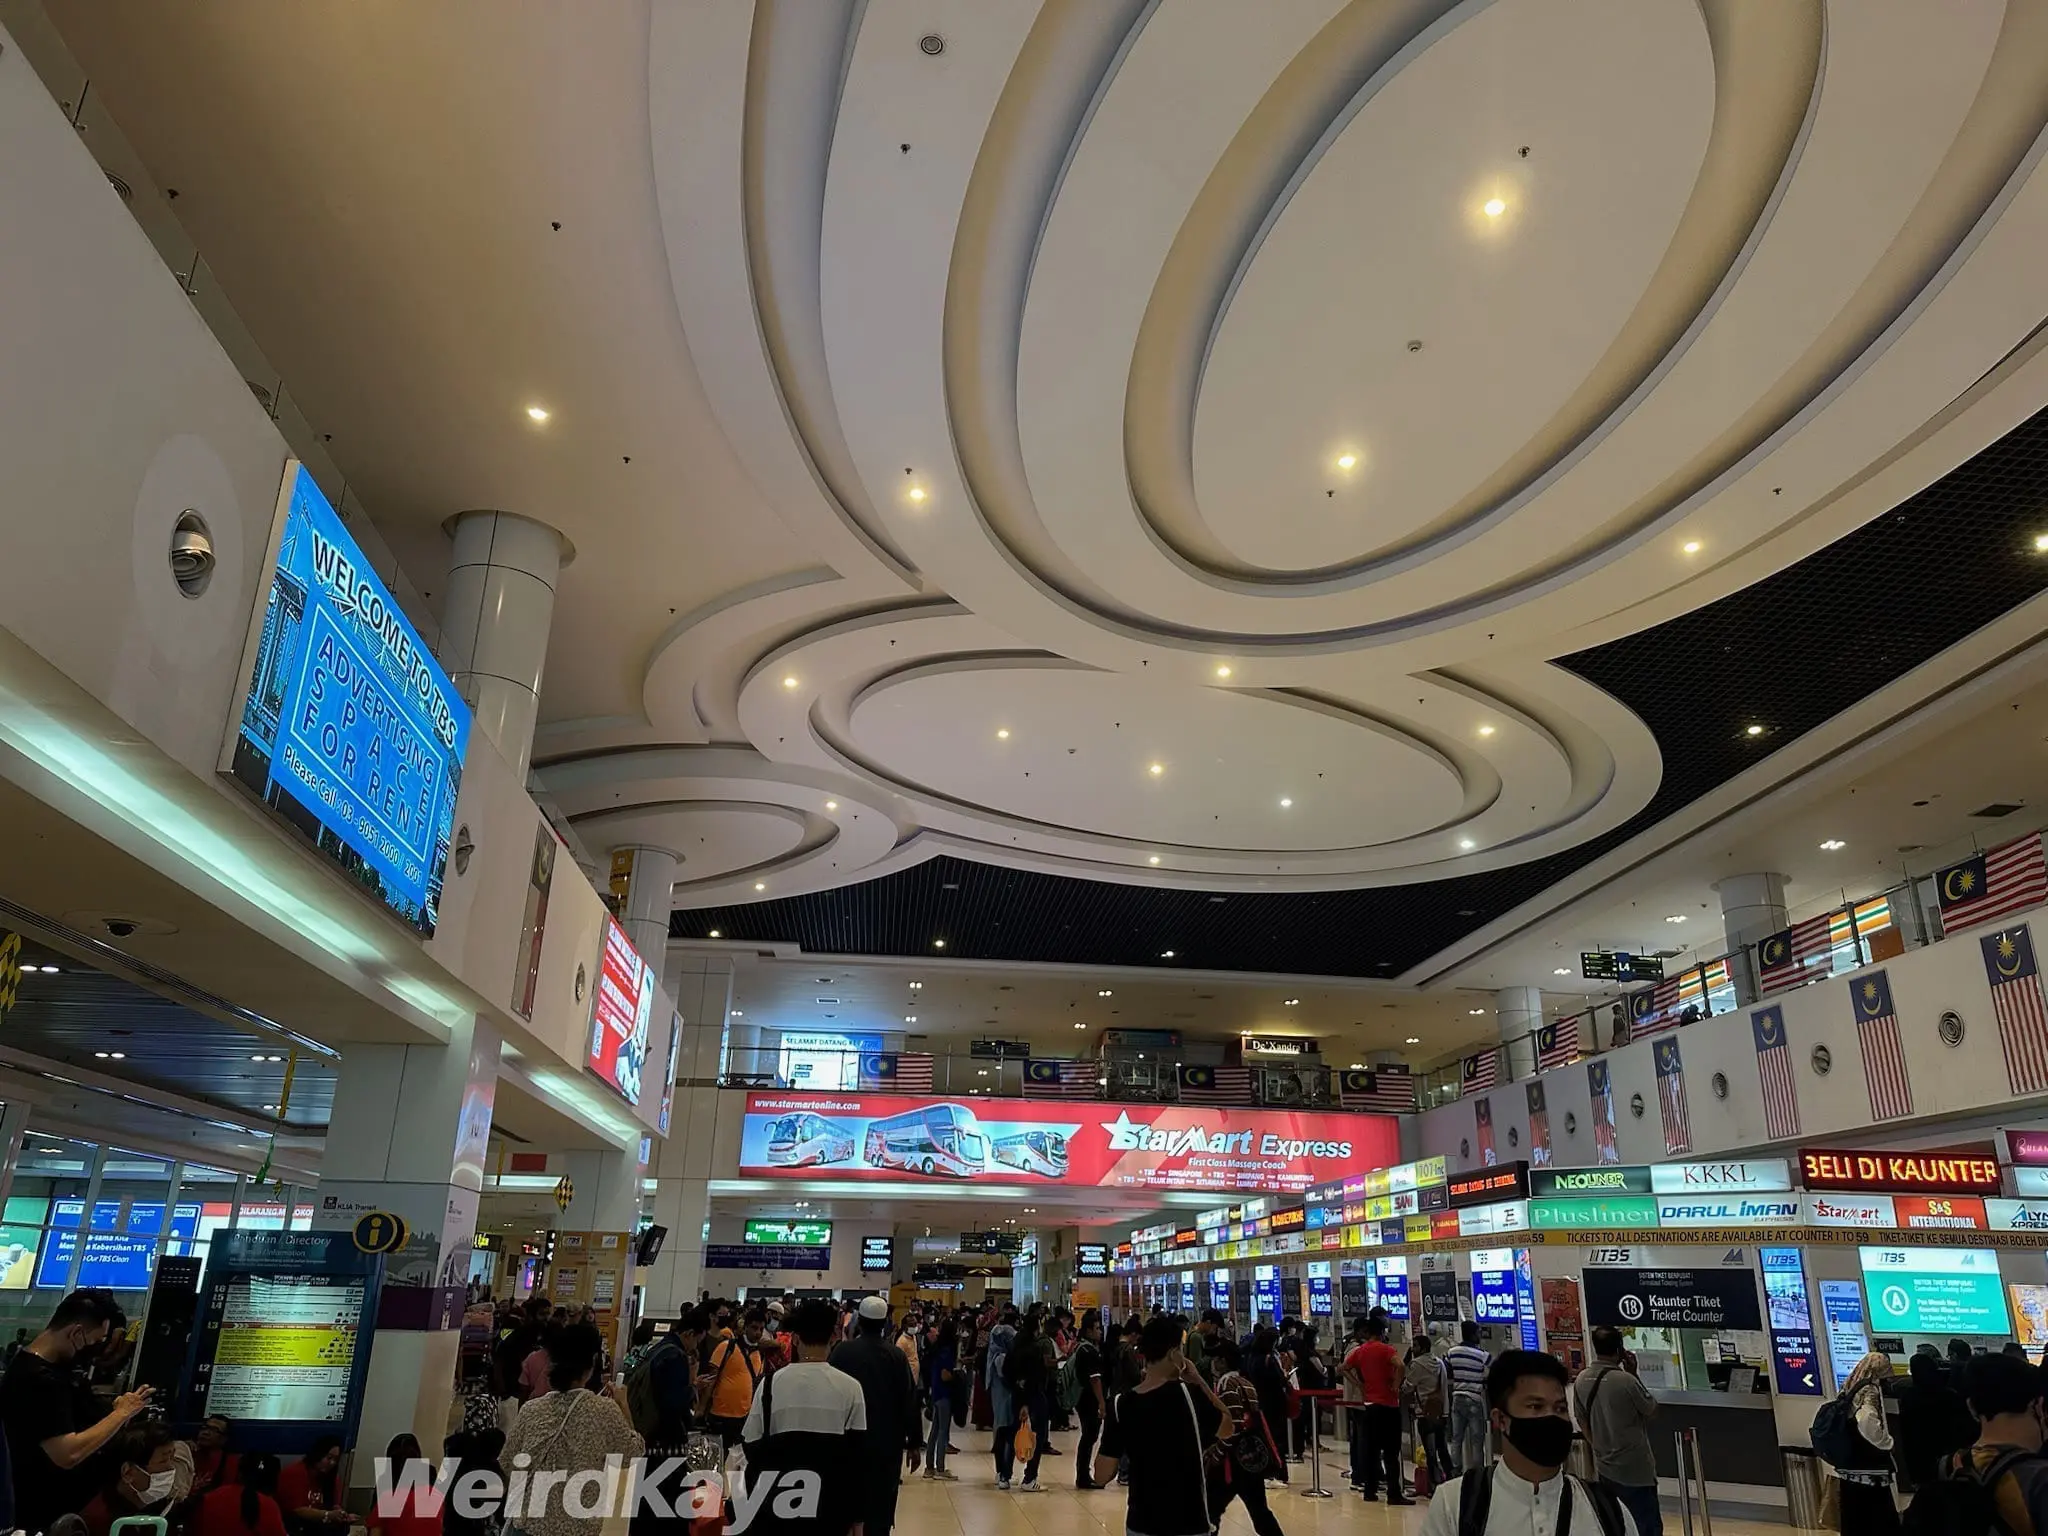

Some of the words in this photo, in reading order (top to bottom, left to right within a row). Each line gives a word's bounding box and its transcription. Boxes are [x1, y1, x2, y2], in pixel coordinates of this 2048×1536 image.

[312, 528, 410, 668] WELCOME
[409, 650, 432, 699] TO
[429, 687, 457, 747] TBS
[318, 632, 434, 785] ADVERTISING
[303, 700, 357, 779] FOR
[367, 768, 426, 846] RENT
[283, 744, 317, 788] Please
[317, 777, 336, 809] Call
[342, 801, 354, 825] 03
[358, 816, 379, 848] 9051
[380, 839, 400, 867] 2000
[404, 859, 422, 885] 2001
[1618, 962, 1630, 972] L4
[754, 1099, 861, 1110] www.starmartonline.com
[1260, 1134, 1353, 1161] Express
[1188, 1157, 1206, 1167] First
[1208, 1158, 1227, 1167] Class
[1228, 1159, 1262, 1170] Massage
[1262, 1160, 1287, 1169] Coach
[1805, 1154, 1852, 1180] BELI
[1857, 1156, 1884, 1181] DI
[1889, 1157, 1998, 1183] KAUNTER
[1167, 1170, 1203, 1178] SINGAPORE
[1554, 1172, 1628, 1190] NEOLINER
[1683, 1163, 1757, 1184] KKKL
[337, 1203, 353, 1211] KLIA
[1533, 1203, 1655, 1224] Plusliner
[1661, 1205, 1736, 1218] DARUL
[1927, 1199, 1953, 1217] S&S
[1908, 1215, 1977, 1229] INTERNATIONAL
[233, 1233, 277, 1244] Panduan
[285, 1234, 333, 1247] Directory
[1532, 1232, 1545, 1243] 59
[1567, 1232, 1601, 1243] TICKETS
[1602, 1232, 1615, 1243] TO
[1615, 1232, 1632, 1242] ALL
[1633, 1231, 1699, 1242] DESTINATIONS
[1701, 1231, 1719, 1242] ARE
[1721, 1231, 1773, 1242] AVAILABLE
[1776, 1230, 1788, 1241] AT
[1789, 1230, 1833, 1241] COUNTER
[1841, 1231, 1854, 1241] TO
[1856, 1232, 1869, 1242] 59
[1879, 1232, 1926, 1243] TIKET-TIKET
[1927, 1234, 1938, 1244] KE
[1939, 1234, 1967, 1245] SEMUA
[1968, 1235, 2009, 1246] DESTINASI
[2011, 1236, 2036, 1247] BOLEH
[1624, 1299, 1637, 1315] 18
[1648, 1294, 1691, 1307] Kaunter
[1693, 1295, 1721, 1308] Tiket
[1891, 1292, 1903, 1310] A
[1650, 1308, 1680, 1321] Ticket
[1682, 1309, 1724, 1323] Counter
[1777, 1336, 1802, 1345] COUNTER
